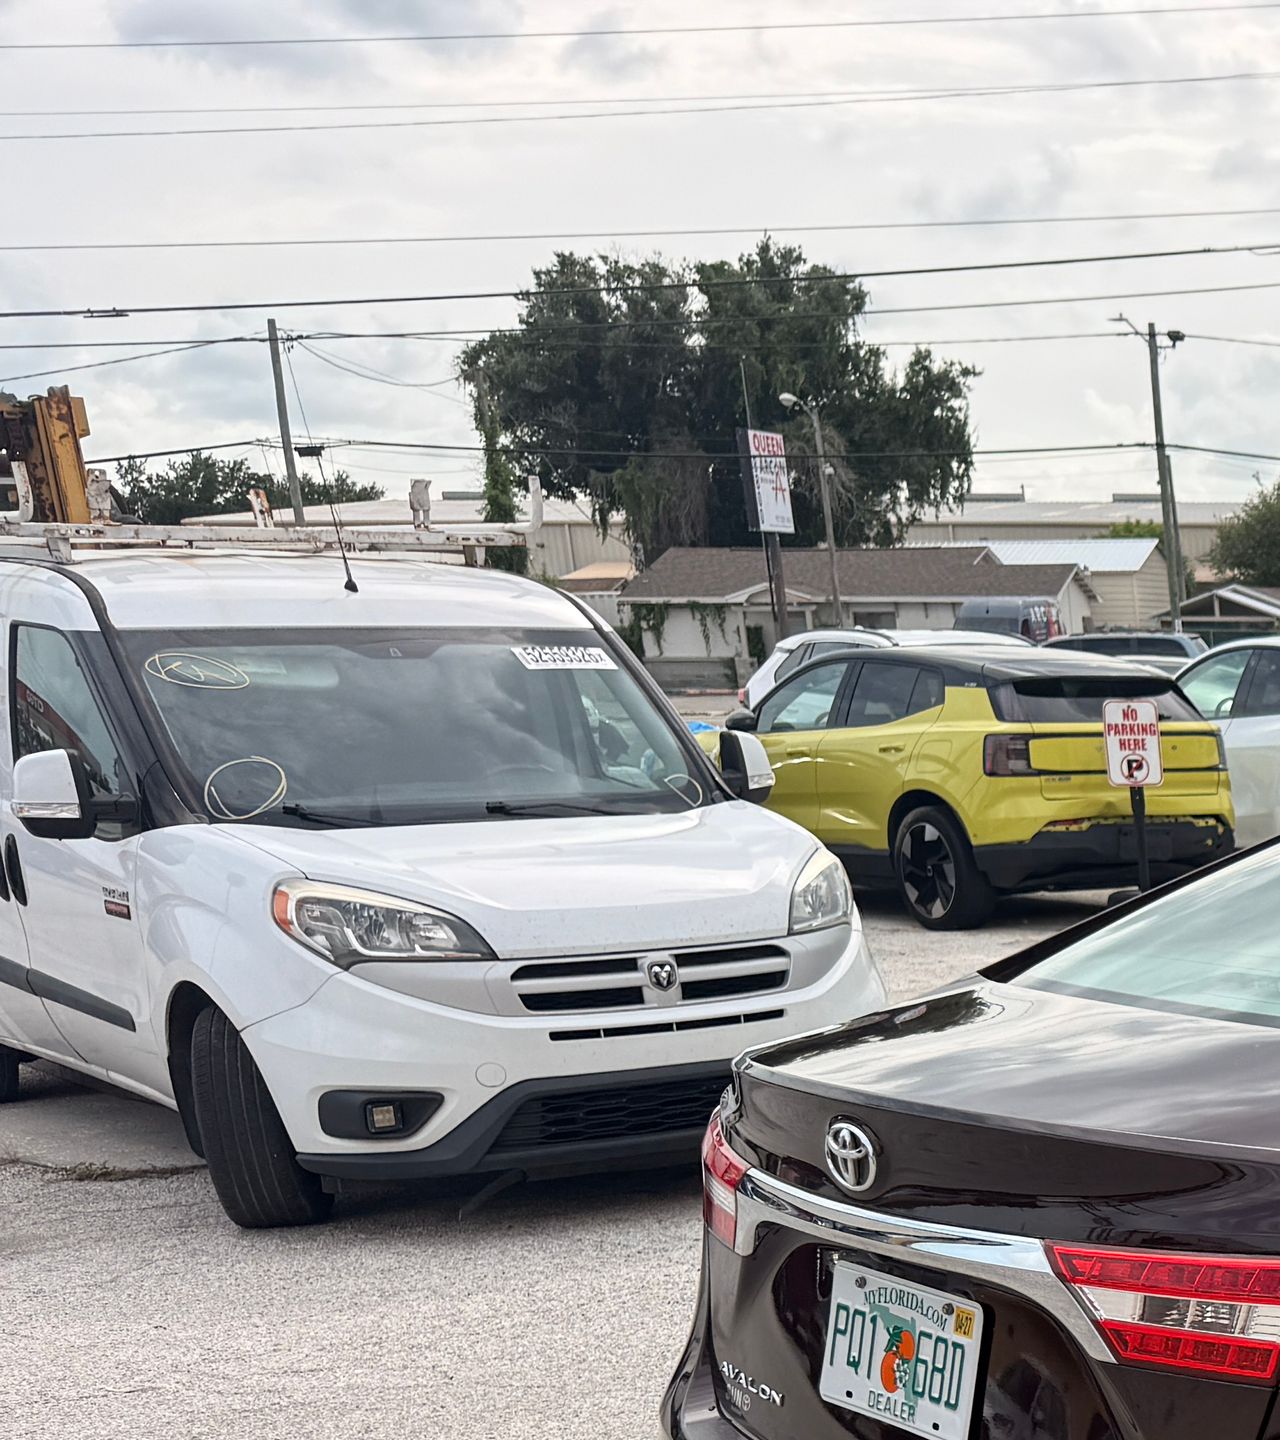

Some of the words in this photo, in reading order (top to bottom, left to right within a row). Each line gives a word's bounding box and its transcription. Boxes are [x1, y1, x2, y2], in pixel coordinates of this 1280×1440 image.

[753, 433, 783, 456] QUEEN
[1122, 708, 1138, 722] NO
[1107, 723, 1157, 737] PARKING
[1119, 738, 1147, 751] HERE
[720, 1361, 783, 1407] AVALON
[868, 1390, 916, 1424] DEALER
